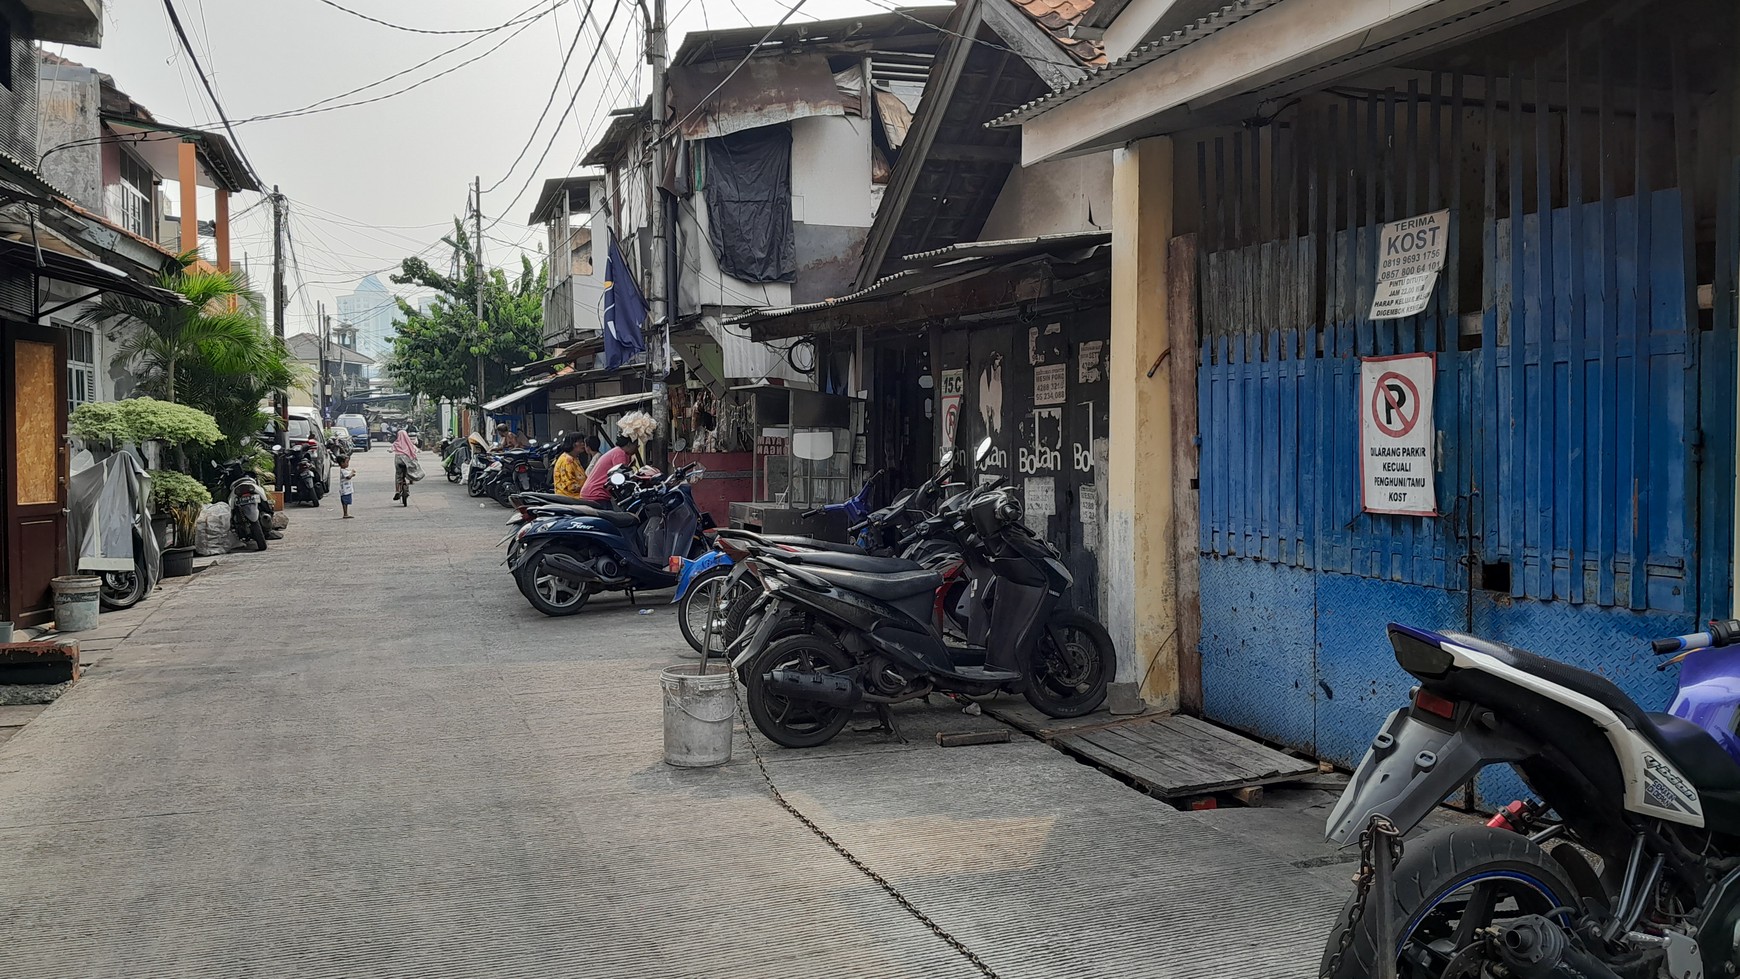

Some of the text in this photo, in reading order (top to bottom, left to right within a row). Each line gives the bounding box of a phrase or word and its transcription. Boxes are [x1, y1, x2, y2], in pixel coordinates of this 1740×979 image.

[1395, 216, 1435, 232] TERIMA
[1387, 226, 1440, 256] KOST
[1383, 258, 1400, 268] 0819
[1423, 249, 1440, 260] 1756
[1382, 269, 1399, 280] 0857
[1402, 266, 1415, 276] 800
[1371, 447, 1426, 457] DILARANG PARKIR
[1383, 462, 1411, 472] KECUALI
[1389, 492, 1407, 502] KOST
